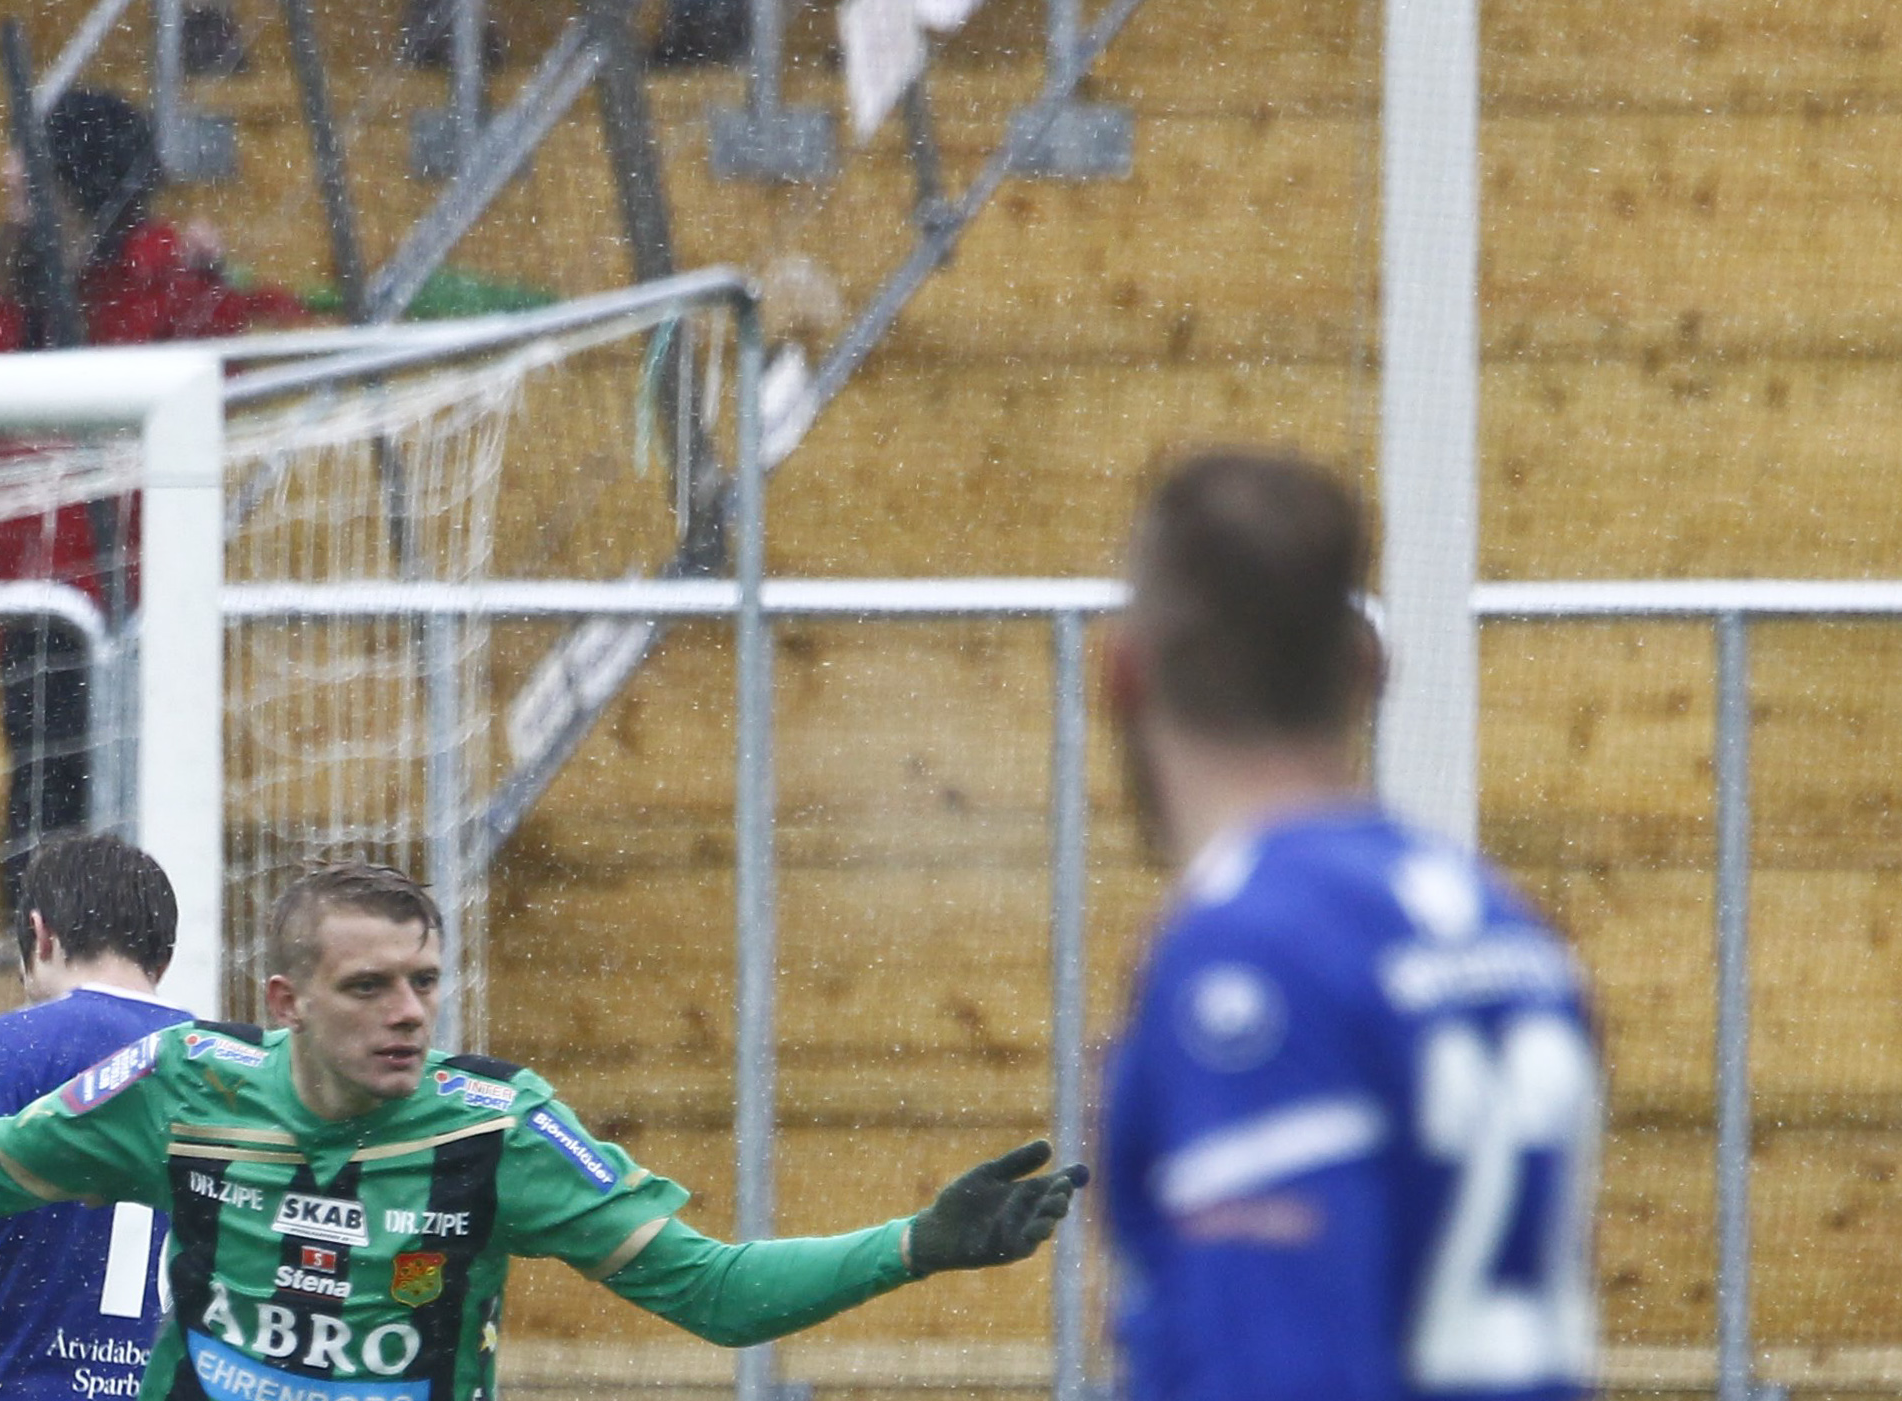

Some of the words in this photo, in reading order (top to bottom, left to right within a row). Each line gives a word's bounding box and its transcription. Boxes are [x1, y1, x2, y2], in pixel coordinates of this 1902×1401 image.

[464, 1093, 511, 1112] SPORT
[466, 1080, 515, 1100] INTER
[532, 1112, 615, 1184] Björnkläder
[189, 1171, 264, 1211] DR.ZIPE
[283, 1198, 363, 1230] SKAB
[385, 1209, 471, 1237] DR.ZIPE
[100, 1201, 176, 1319] 1
[274, 1265, 352, 1299] Stena
[202, 1281, 421, 1375] ÅBRO
[72, 1368, 141, 1400] Sparb
